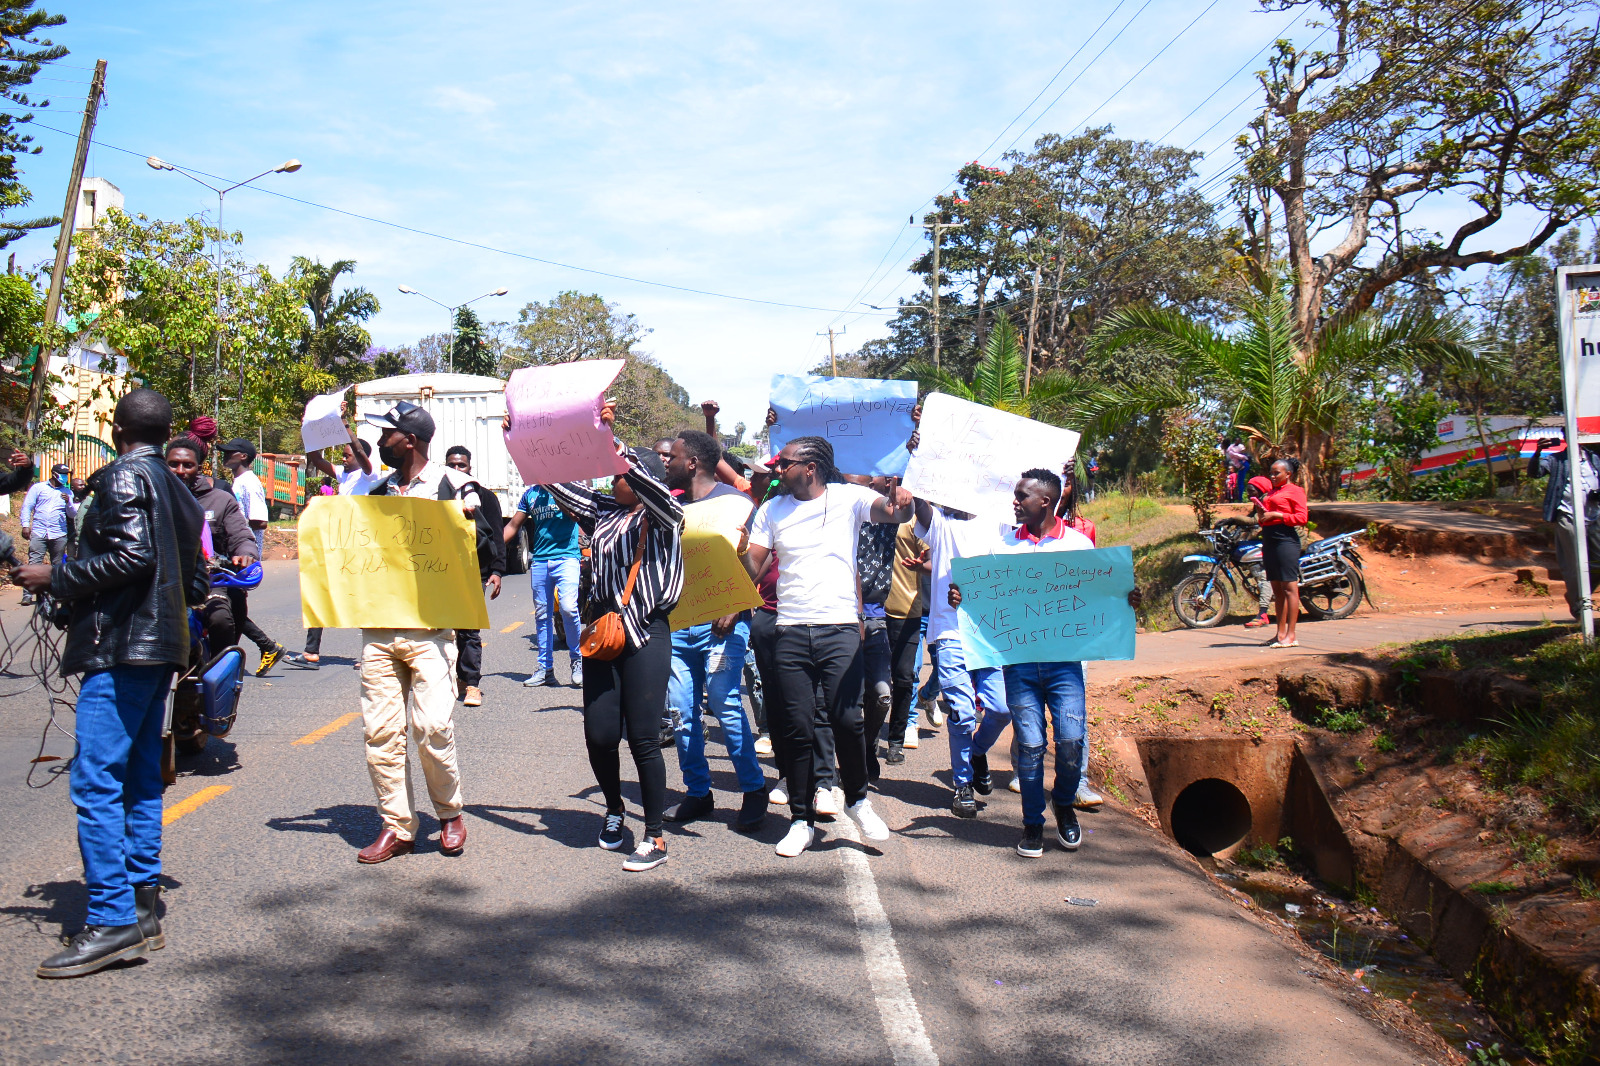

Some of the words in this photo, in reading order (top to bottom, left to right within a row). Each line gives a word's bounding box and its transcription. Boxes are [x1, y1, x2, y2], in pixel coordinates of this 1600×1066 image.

[793, 388, 839, 416] AKI
[340, 551, 389, 576] KILA
[402, 553, 449, 574] SIKU
[961, 565, 1044, 585] Justice
[1054, 562, 1113, 583] Delayed
[967, 589, 980, 601] is
[986, 583, 1039, 600] Justice
[1045, 579, 1082, 594] Denied
[966, 606, 1011, 634] WE
[1024, 595, 1087, 619] NEED
[992, 612, 1105, 654] JUSTICE!!
